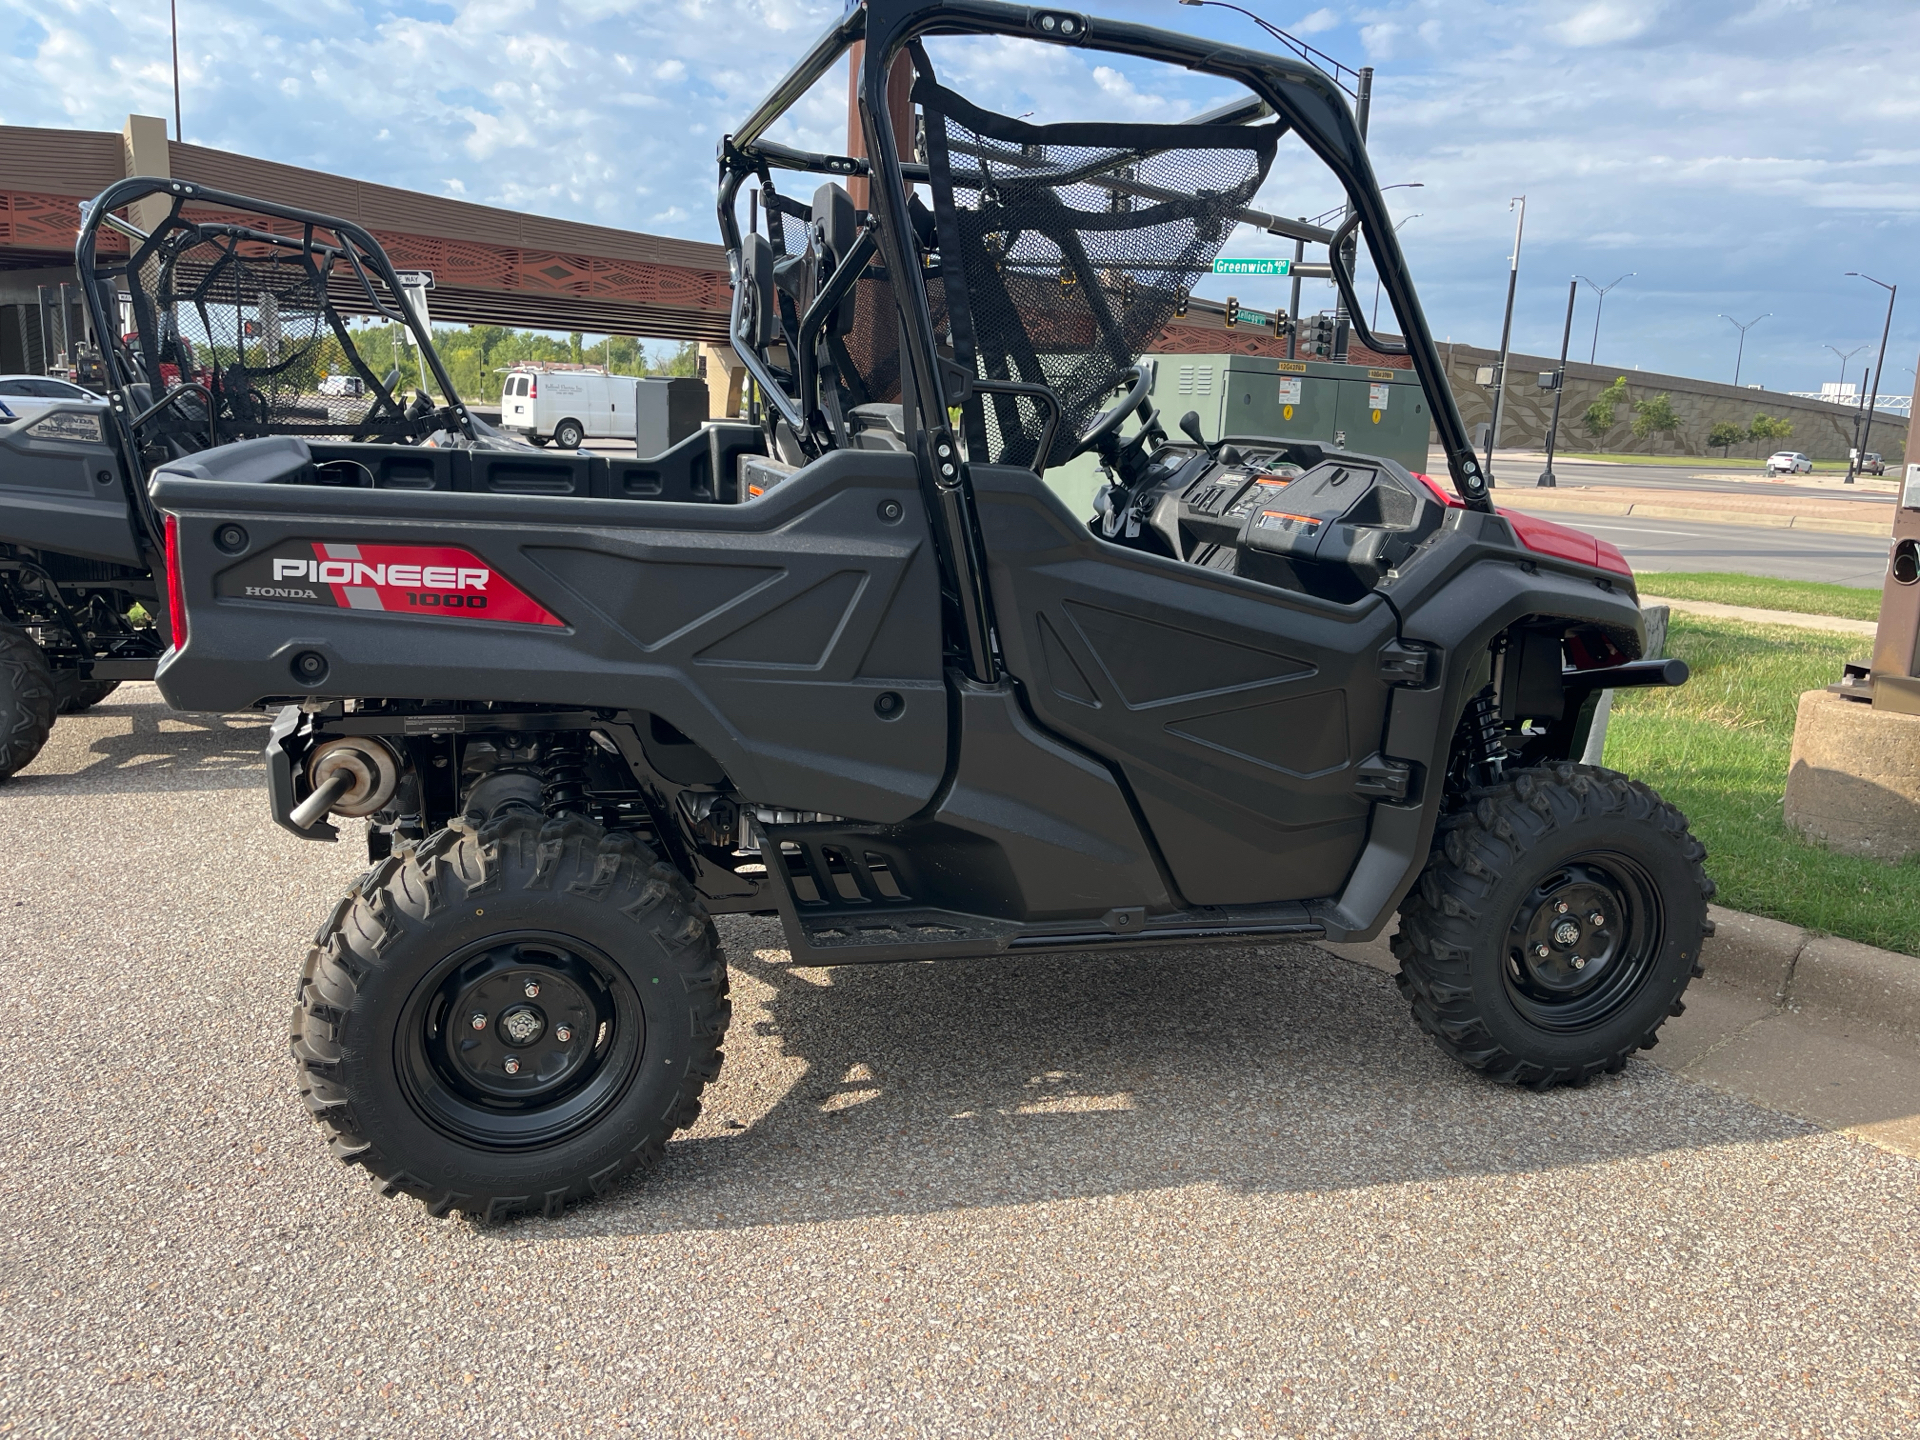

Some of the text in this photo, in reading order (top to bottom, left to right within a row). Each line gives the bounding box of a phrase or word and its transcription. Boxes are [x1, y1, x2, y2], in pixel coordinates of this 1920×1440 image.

[1216, 260, 1274, 273] Greenwich
[1274, 260, 1287, 268] 400
[55, 416, 95, 425] HONDA
[38, 426, 98, 435] PIONEER
[272, 558, 489, 591] PIONEER
[245, 586, 318, 599] HONDA
[405, 592, 488, 609] 1000
[572, 1135, 622, 1171] DIRT
[460, 1166, 565, 1186] MASTER
